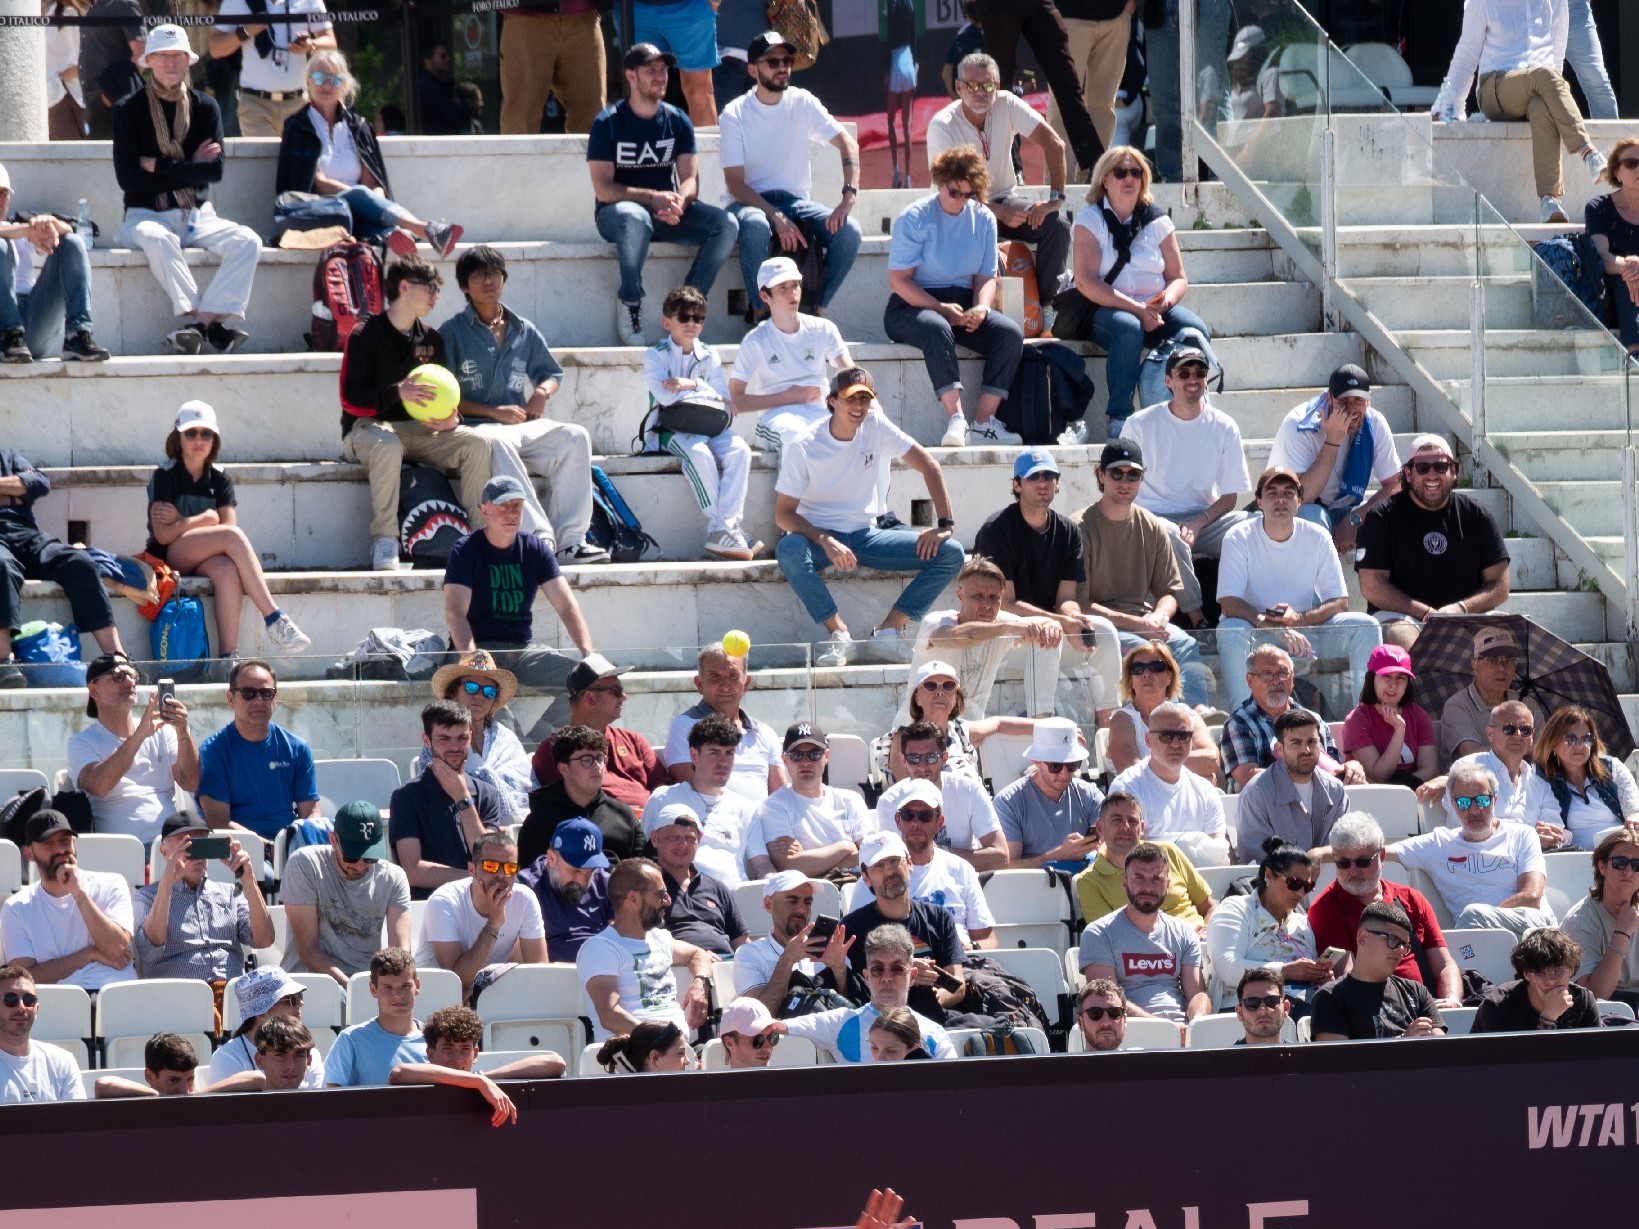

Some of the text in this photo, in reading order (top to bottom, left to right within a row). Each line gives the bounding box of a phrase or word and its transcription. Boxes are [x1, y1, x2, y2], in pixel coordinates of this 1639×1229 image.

[9, 16, 50, 26] ITALICO
[174, 16, 214, 26] ITALICO
[337, 10, 379, 21] ITALICO
[616, 138, 675, 165] EA7
[489, 563, 523, 589] DUN
[1446, 852, 1516, 874] FILA
[1528, 1103, 1625, 1149] WTA
